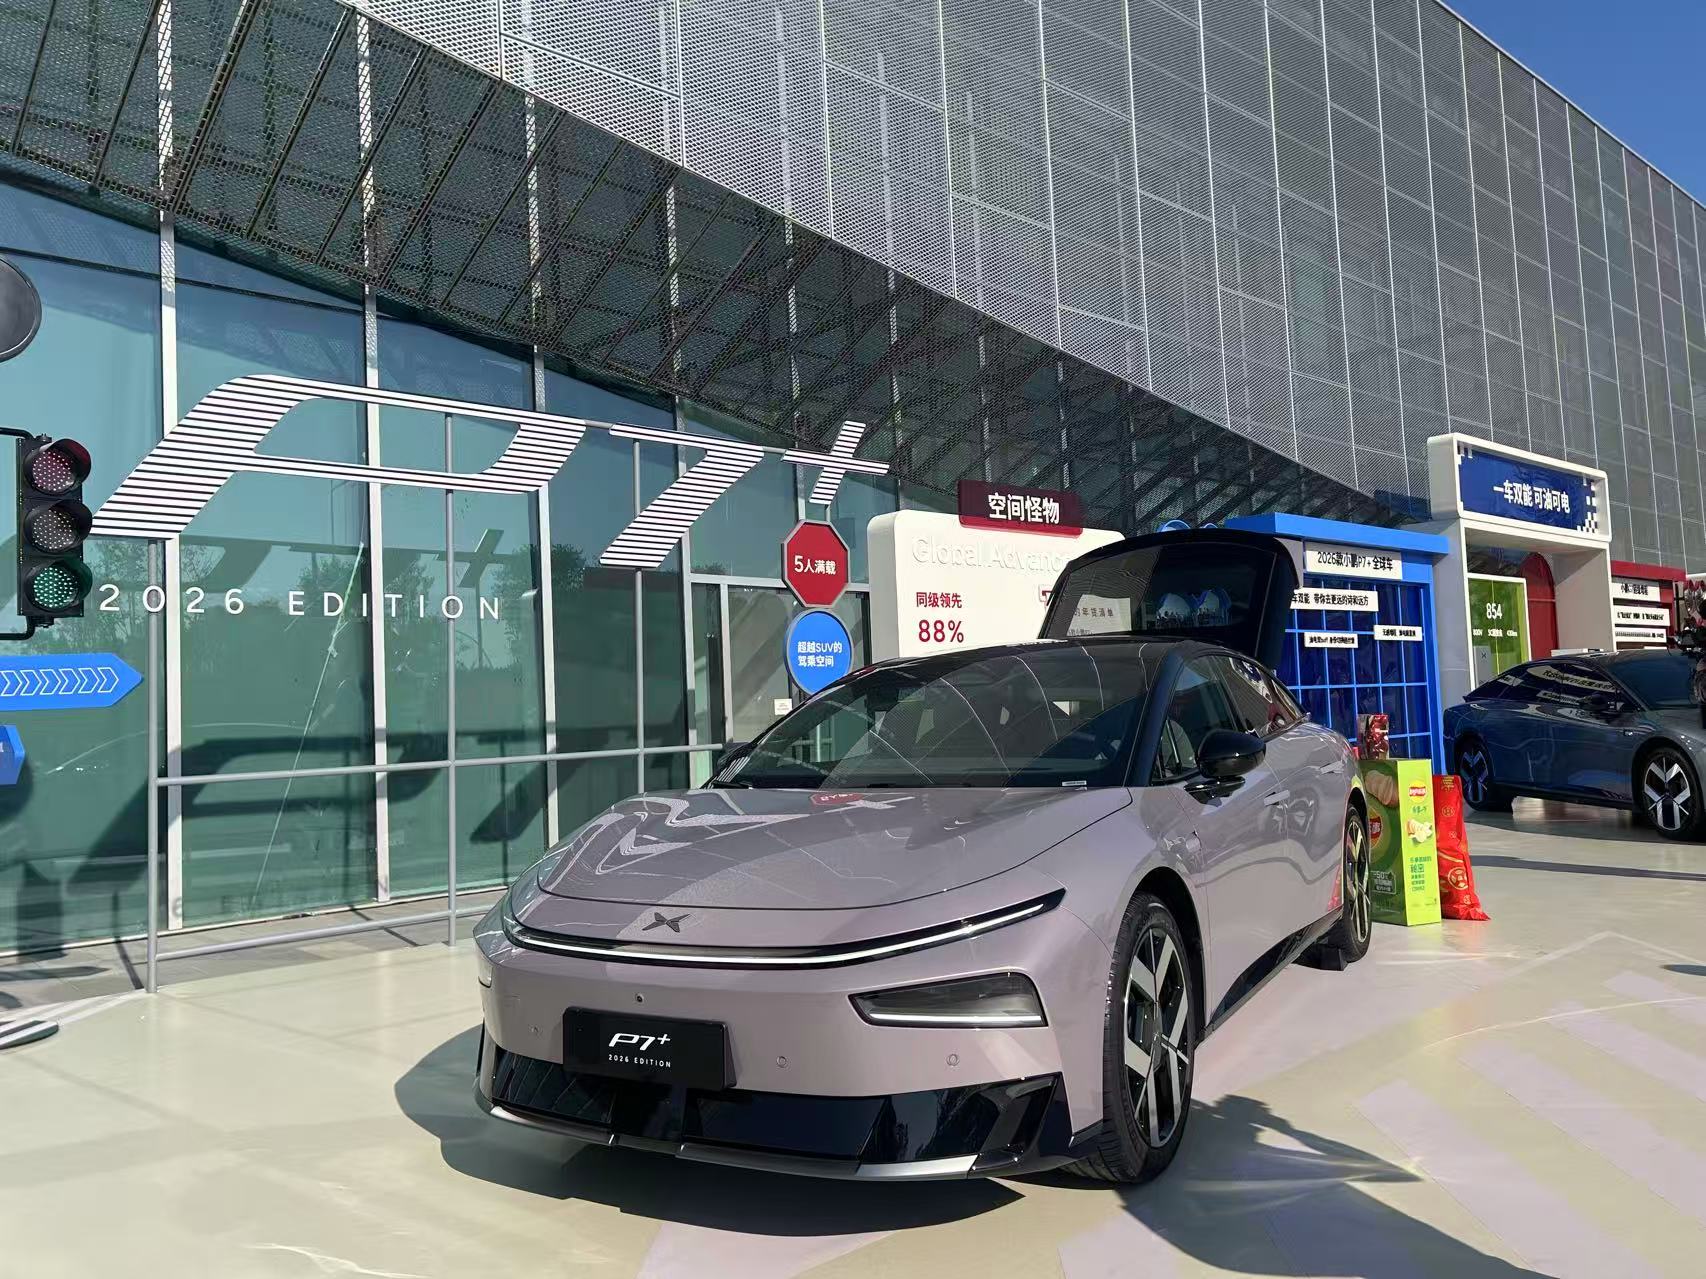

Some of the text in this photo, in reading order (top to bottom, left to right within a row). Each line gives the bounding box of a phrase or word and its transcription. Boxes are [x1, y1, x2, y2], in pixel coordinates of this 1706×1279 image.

[1493, 479, 1571, 514] 一车双能 可油可电
[988, 491, 1060, 525] 空间怪物
[912, 535, 1071, 573] Global Advanc
[794, 555, 836, 576] 5人满载
[99, 584, 501, 621] 2026 EDITION
[915, 592, 963, 609] 同级领先
[1486, 602, 1503, 620] 854
[918, 618, 965, 643] 88%
[797, 641, 843, 654] 超越SUV的
[797, 654, 835, 668] 驾乘空间
[608, 1033, 671, 1051] P7+
[608, 1054, 671, 1067] 2026 EDITION
